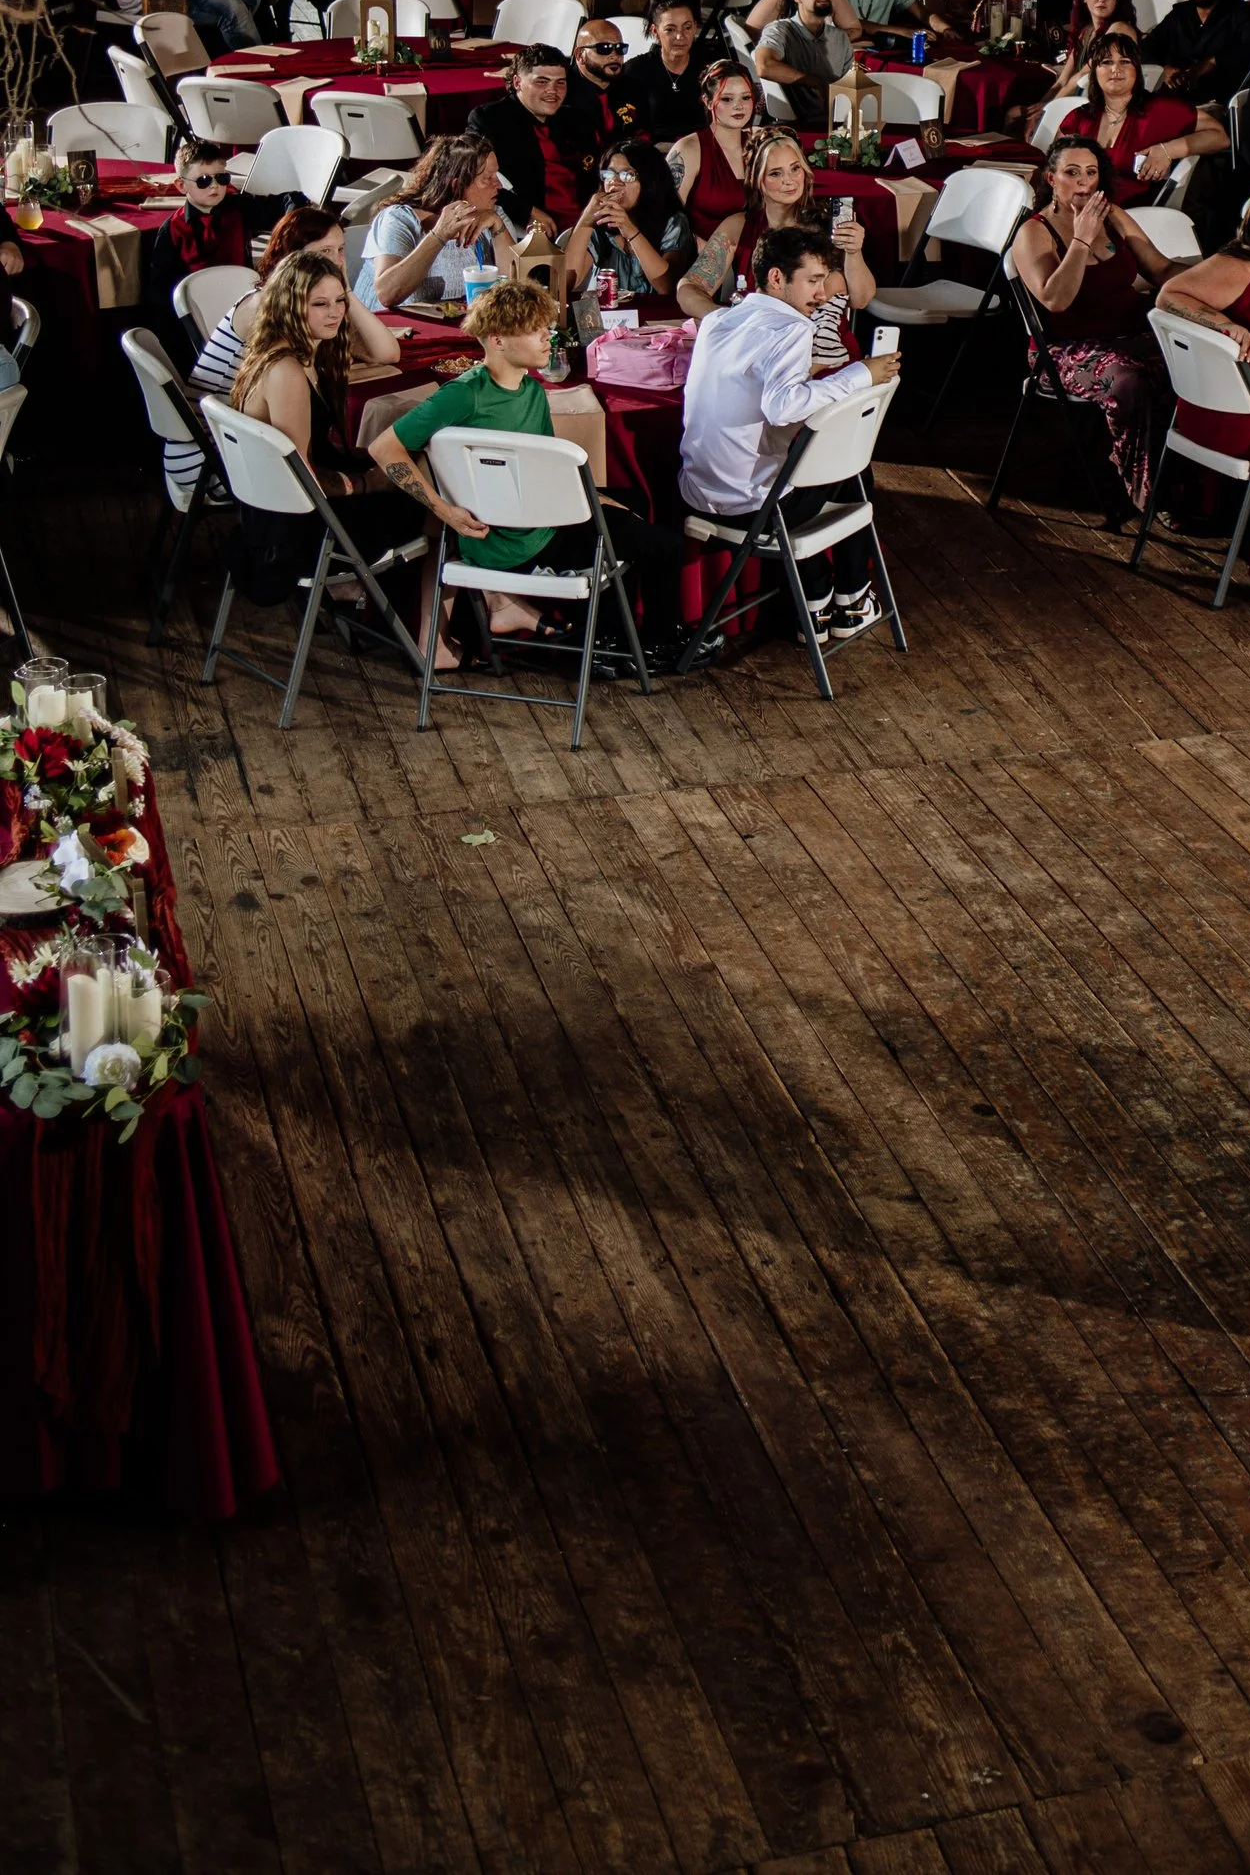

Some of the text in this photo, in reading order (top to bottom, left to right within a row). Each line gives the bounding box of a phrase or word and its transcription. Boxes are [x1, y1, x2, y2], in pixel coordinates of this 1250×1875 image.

[1053, 29, 1060, 41] 9
[930, 130, 938, 144] 6
[79, 164, 87, 179] 7
